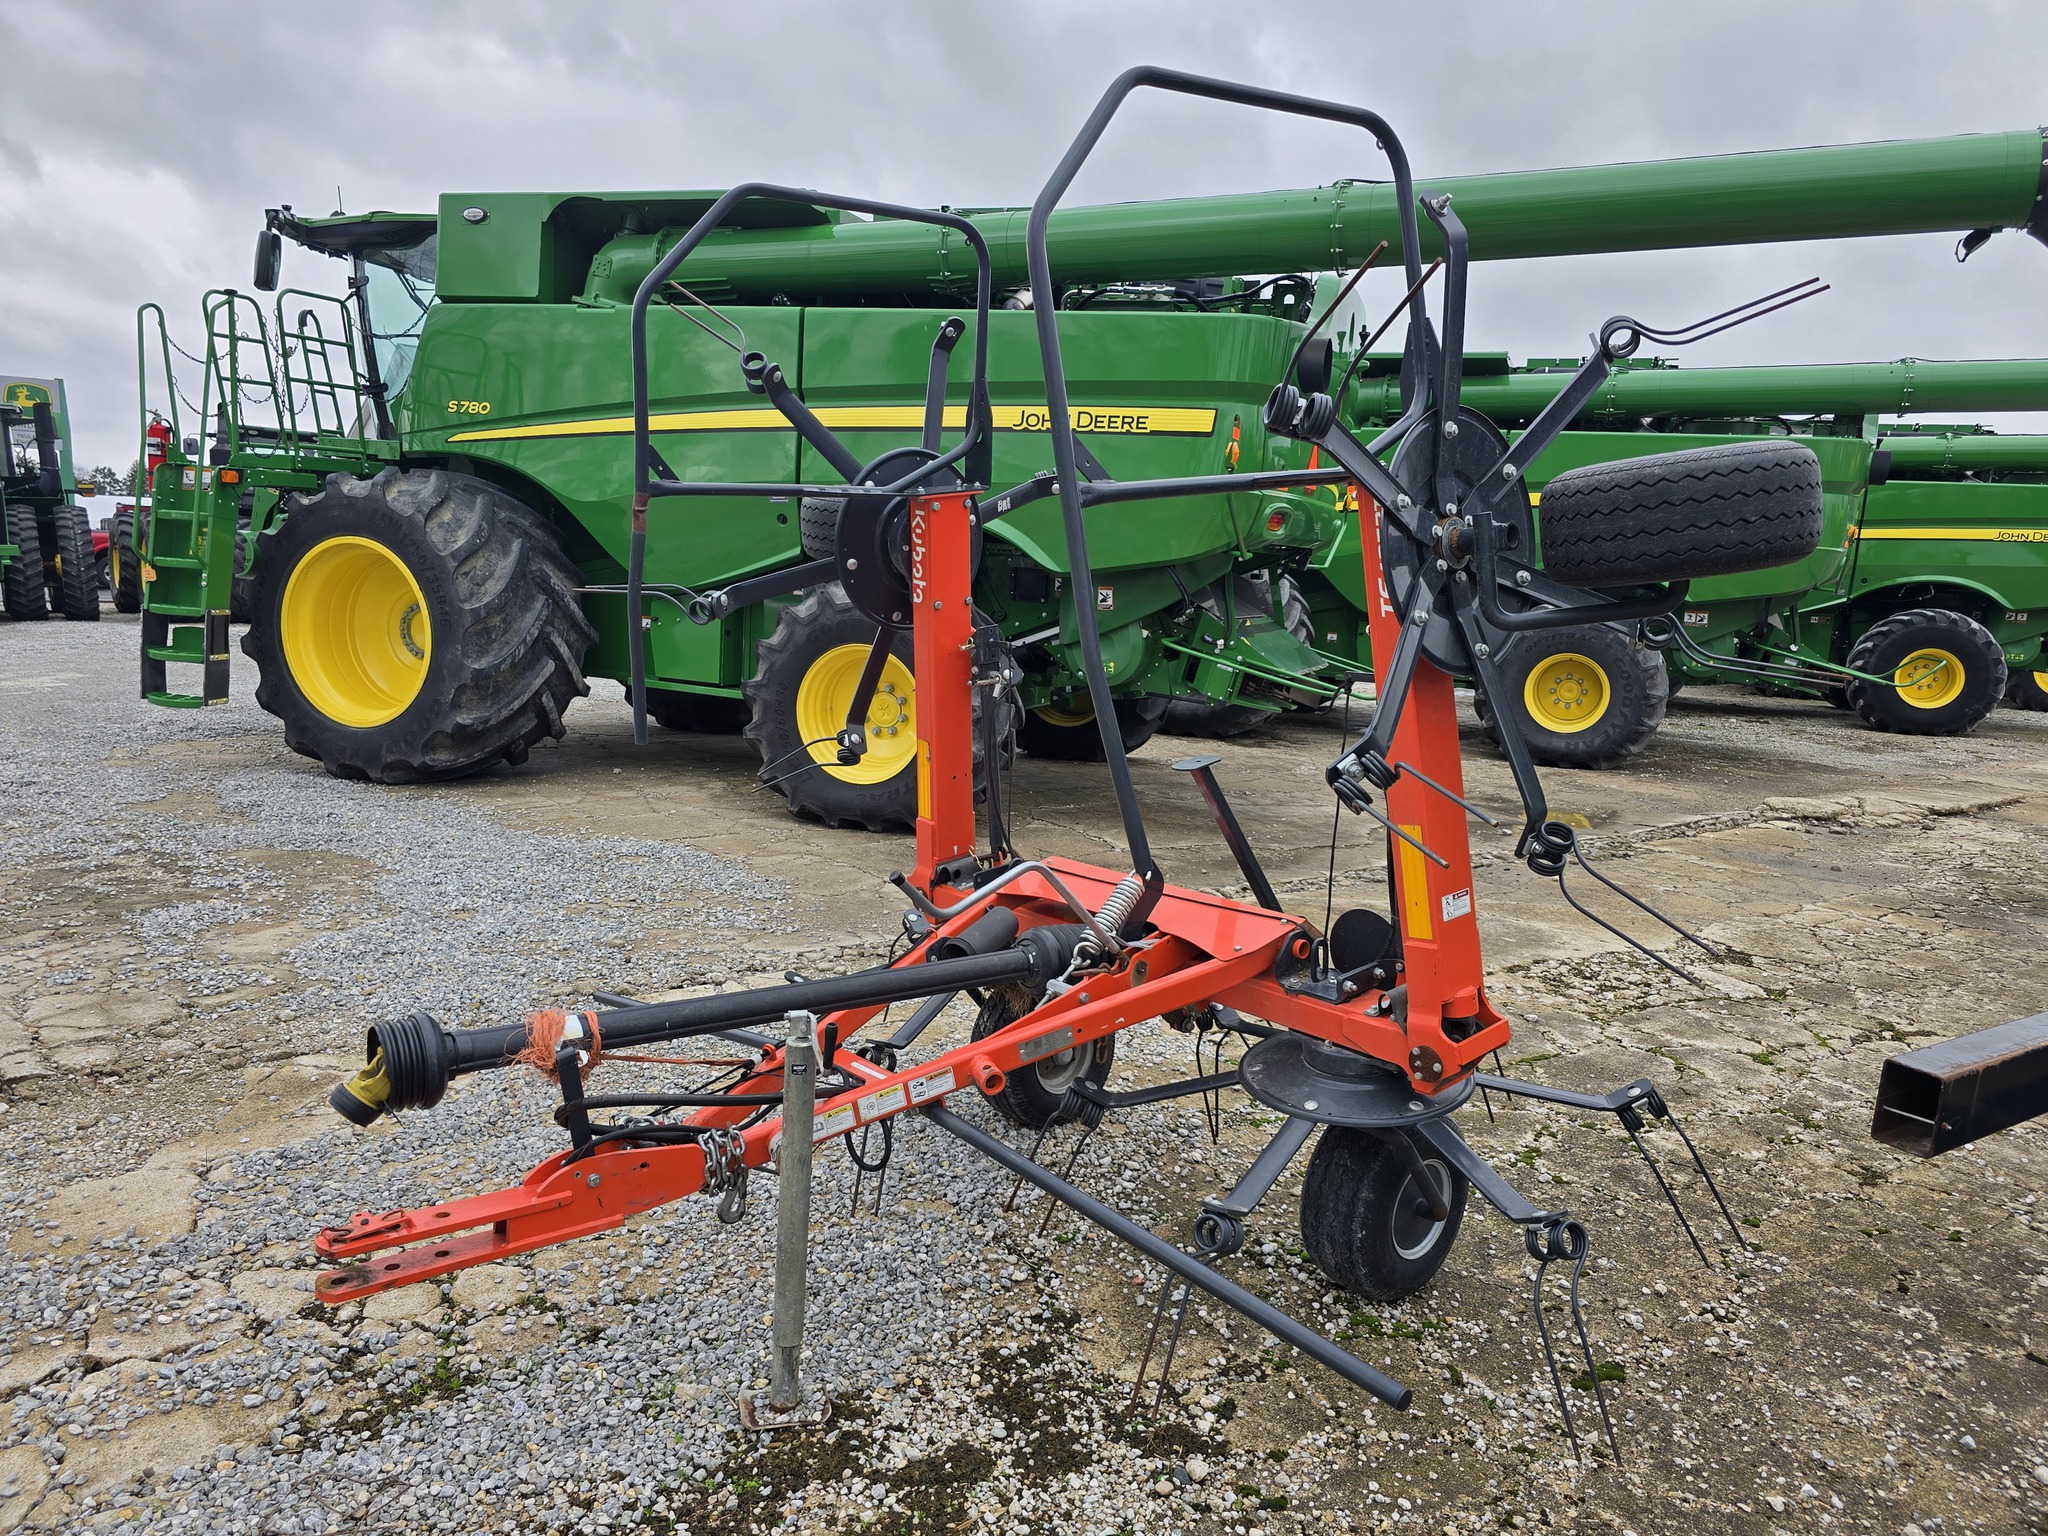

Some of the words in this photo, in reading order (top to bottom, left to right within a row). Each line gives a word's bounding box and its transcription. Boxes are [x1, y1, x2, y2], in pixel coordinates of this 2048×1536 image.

[447, 400, 491, 415] S780
[1012, 410, 1071, 428] JOH
[1076, 411, 1149, 430] DEERE
[1993, 530, 2029, 541] JOHN
[911, 509, 926, 603] Kubota
